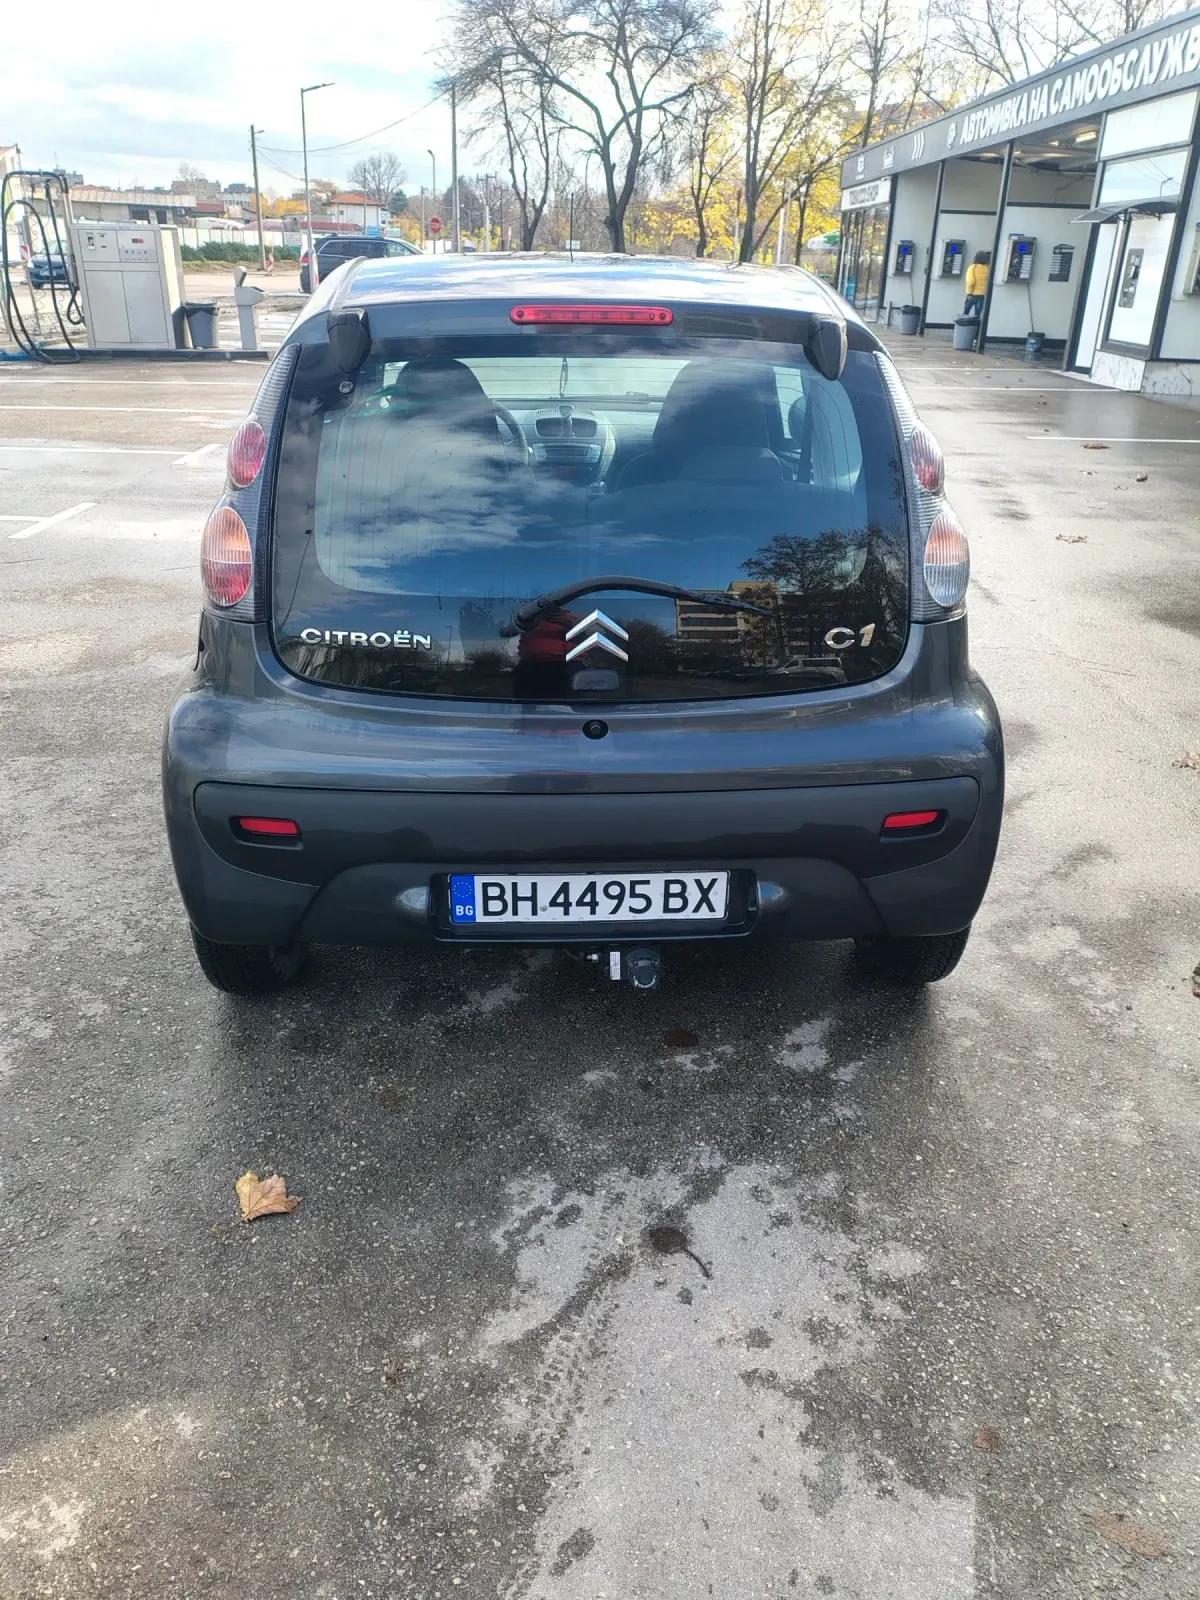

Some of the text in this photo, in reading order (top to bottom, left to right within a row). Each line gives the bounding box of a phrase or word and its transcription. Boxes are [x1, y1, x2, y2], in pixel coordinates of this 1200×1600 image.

[960, 93, 1028, 145] АВТОМИВКА
[1027, 84, 1048, 123] НА
[300, 627, 431, 649] CITROËN
[824, 622, 876, 649] C1
[455, 904, 474, 917] BG
[548, 880, 653, 916] 4495
